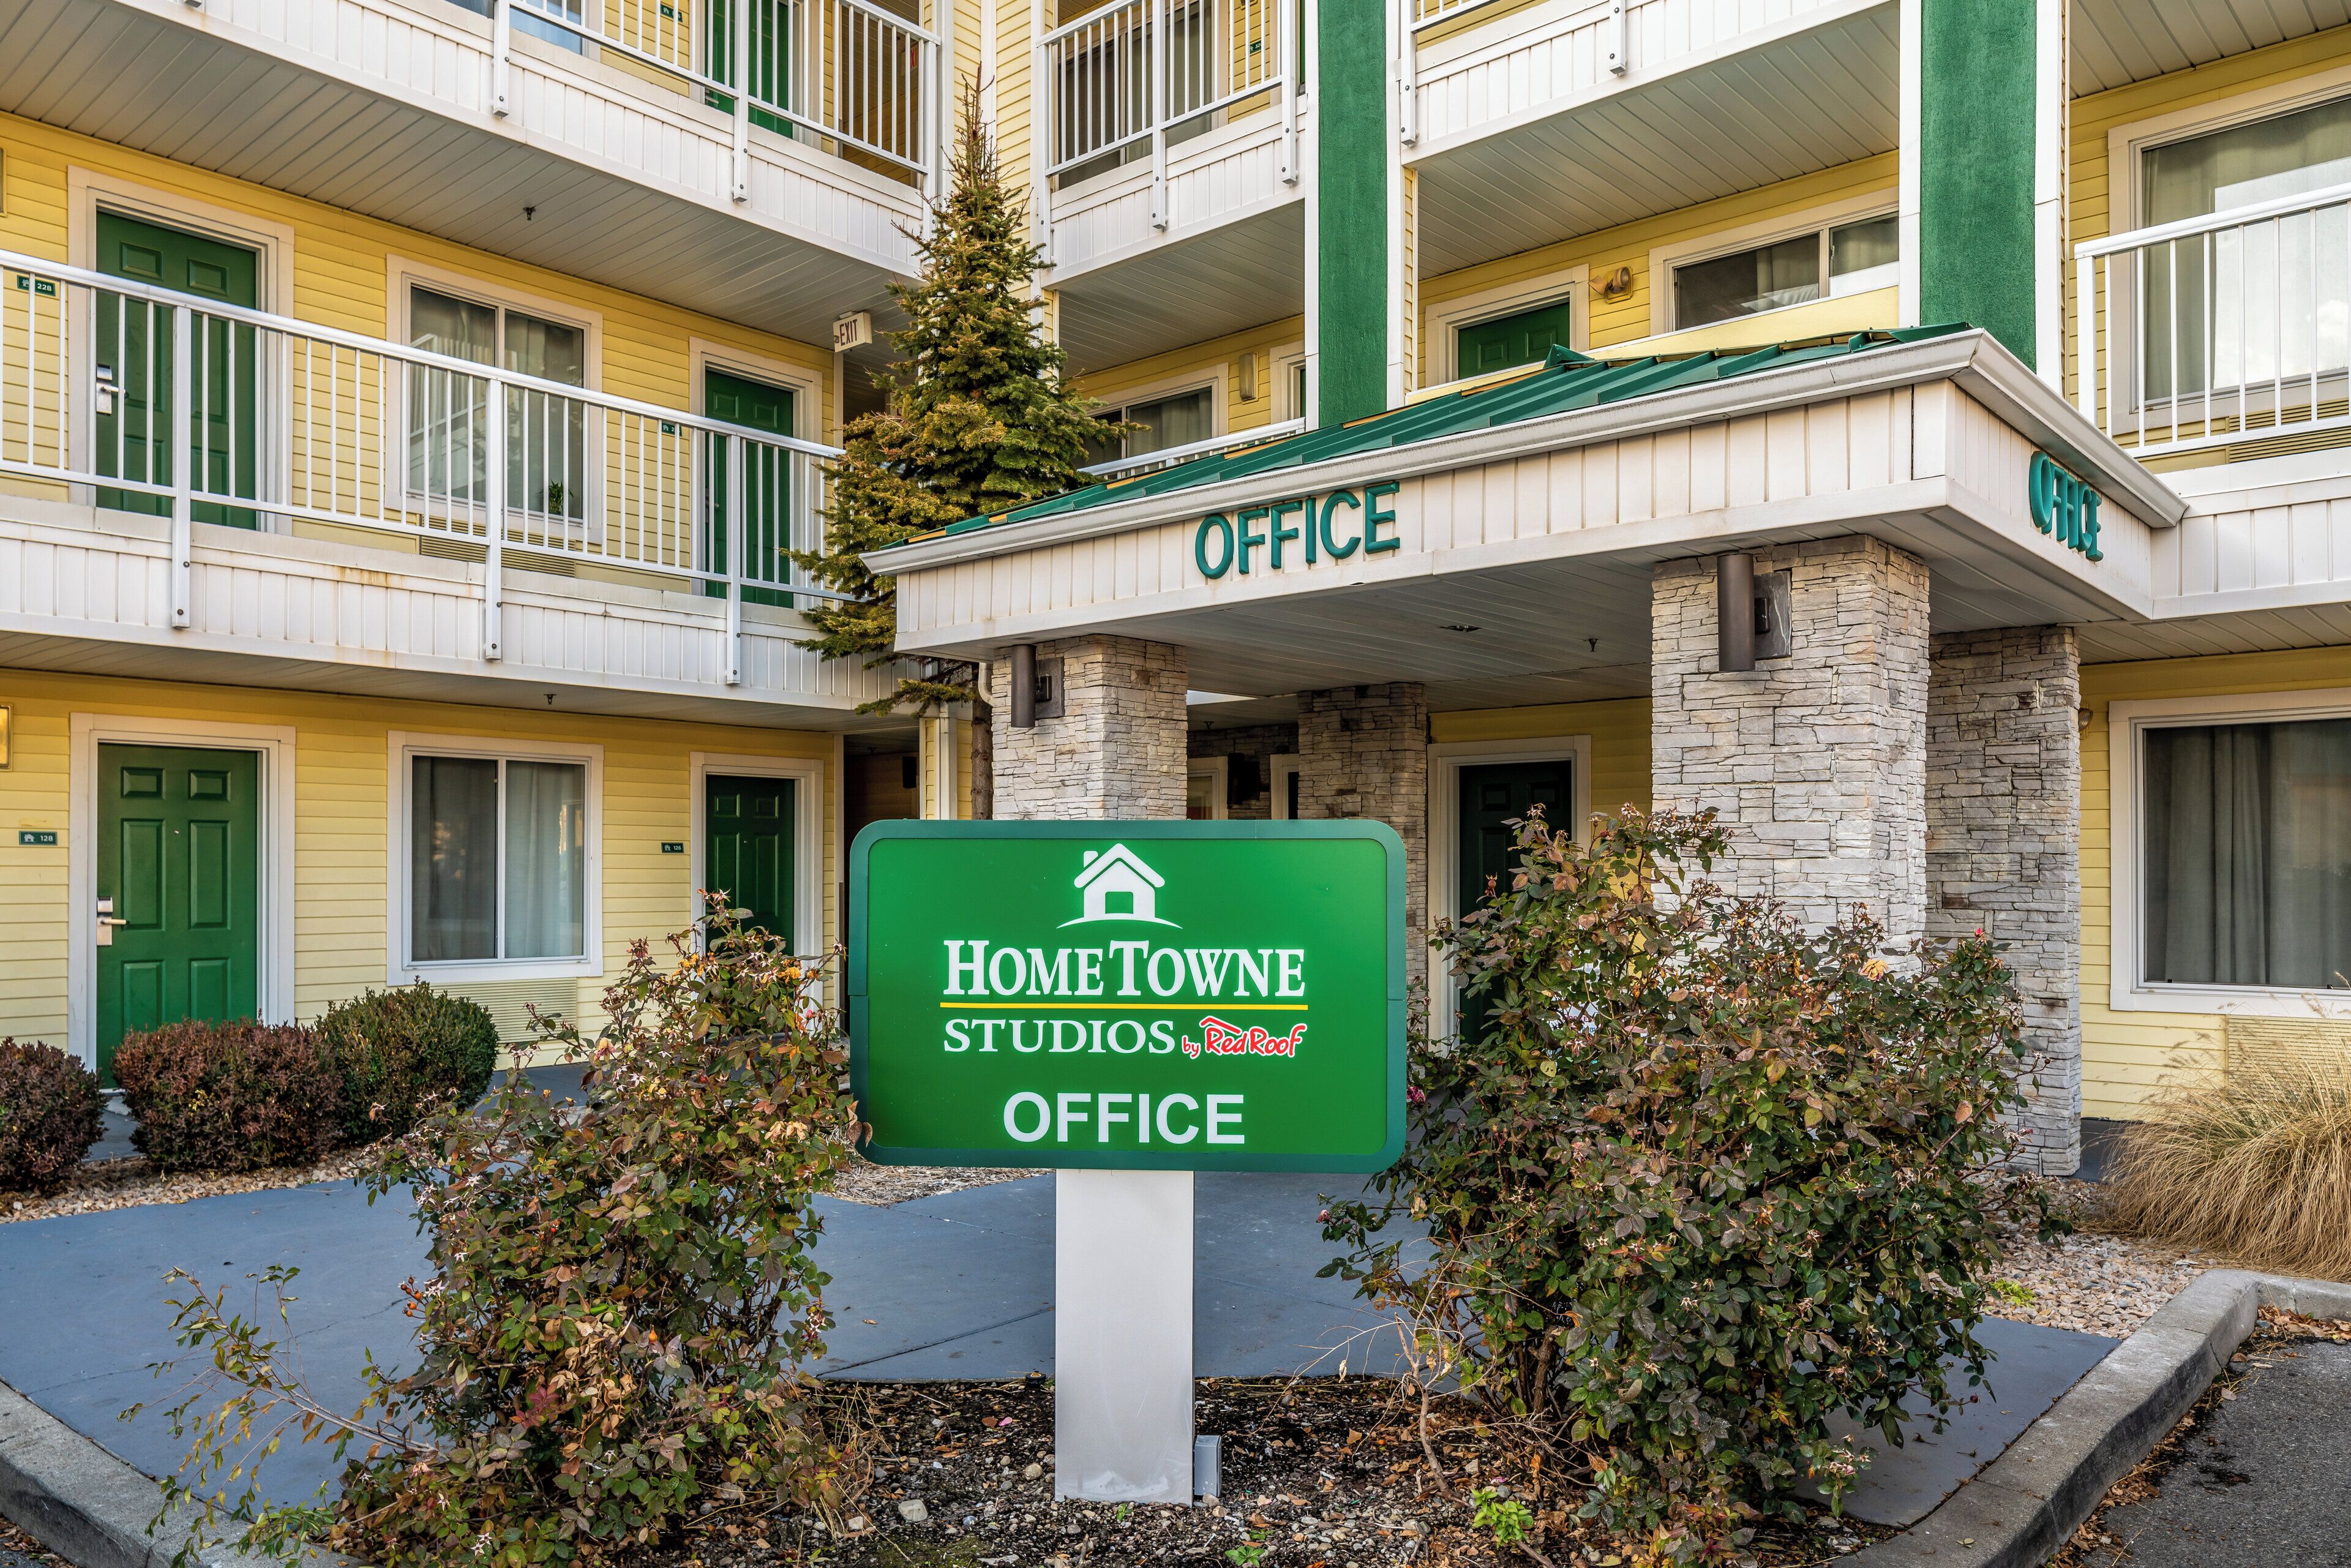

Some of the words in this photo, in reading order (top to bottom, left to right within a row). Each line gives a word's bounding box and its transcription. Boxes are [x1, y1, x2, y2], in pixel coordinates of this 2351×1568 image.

[37, 283, 51, 291] 228
[839, 319, 857, 346] EXIT
[1194, 481, 1400, 580] OFFICE
[943, 1019, 1175, 1054] STUDIOS
[1182, 1035, 1201, 1059] by
[1003, 1092, 1245, 1144] OFFICE
